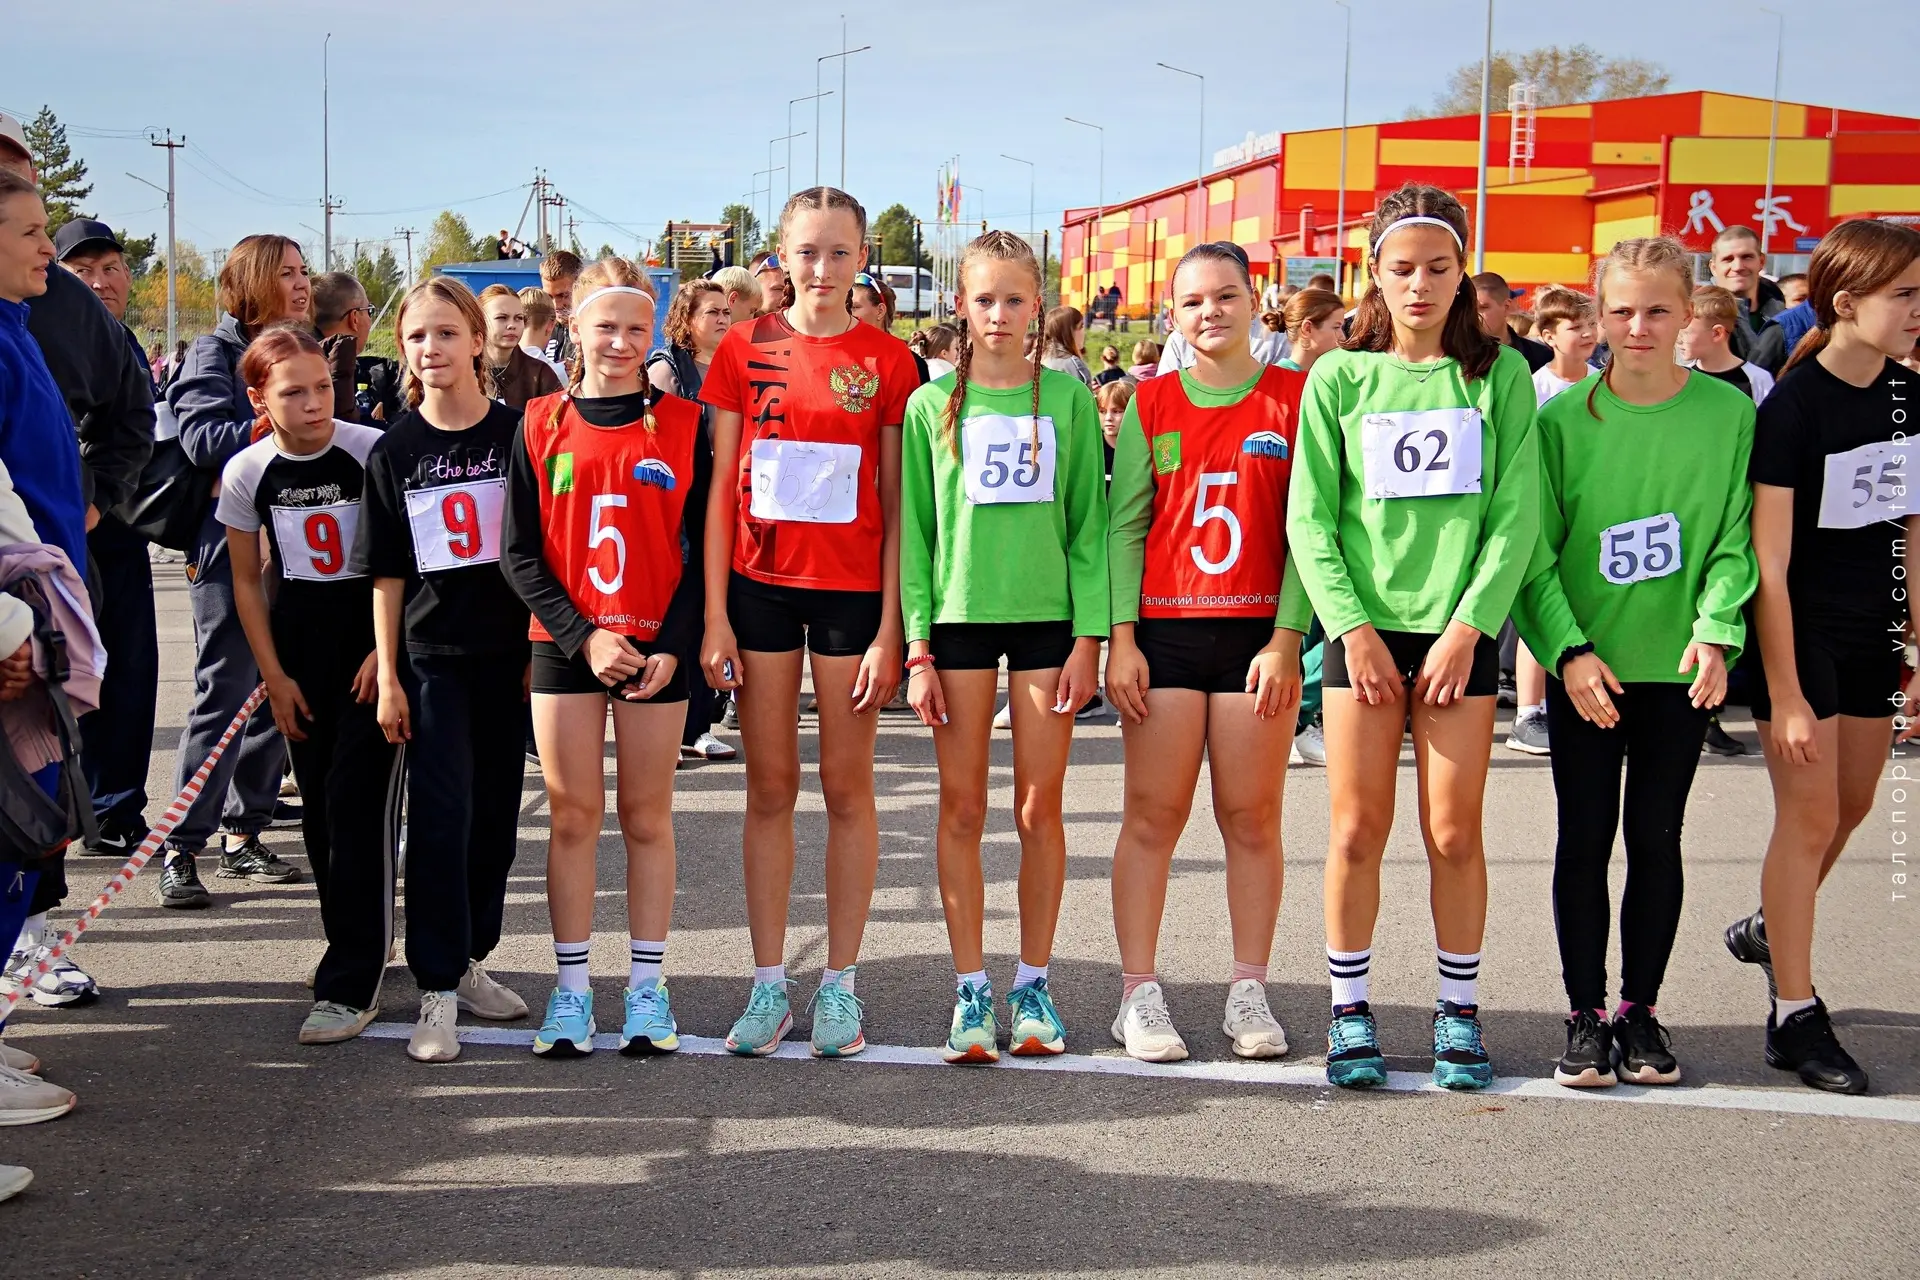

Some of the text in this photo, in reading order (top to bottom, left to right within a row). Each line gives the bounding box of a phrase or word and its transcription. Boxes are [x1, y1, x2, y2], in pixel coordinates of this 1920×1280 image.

[429, 455, 463, 479] the
[466, 448, 497, 476] best
[980, 442, 1043, 488] 55
[1393, 429, 1450, 473] 62
[1852, 460, 1902, 508] 55
[303, 511, 345, 576] 9
[441, 490, 483, 560] 9
[587, 494, 628, 595] 5
[1190, 471, 1242, 575] 5
[1608, 521, 1673, 579] 55
[1140, 594, 1193, 606] Талицкий
[1197, 593, 1262, 606] городской
